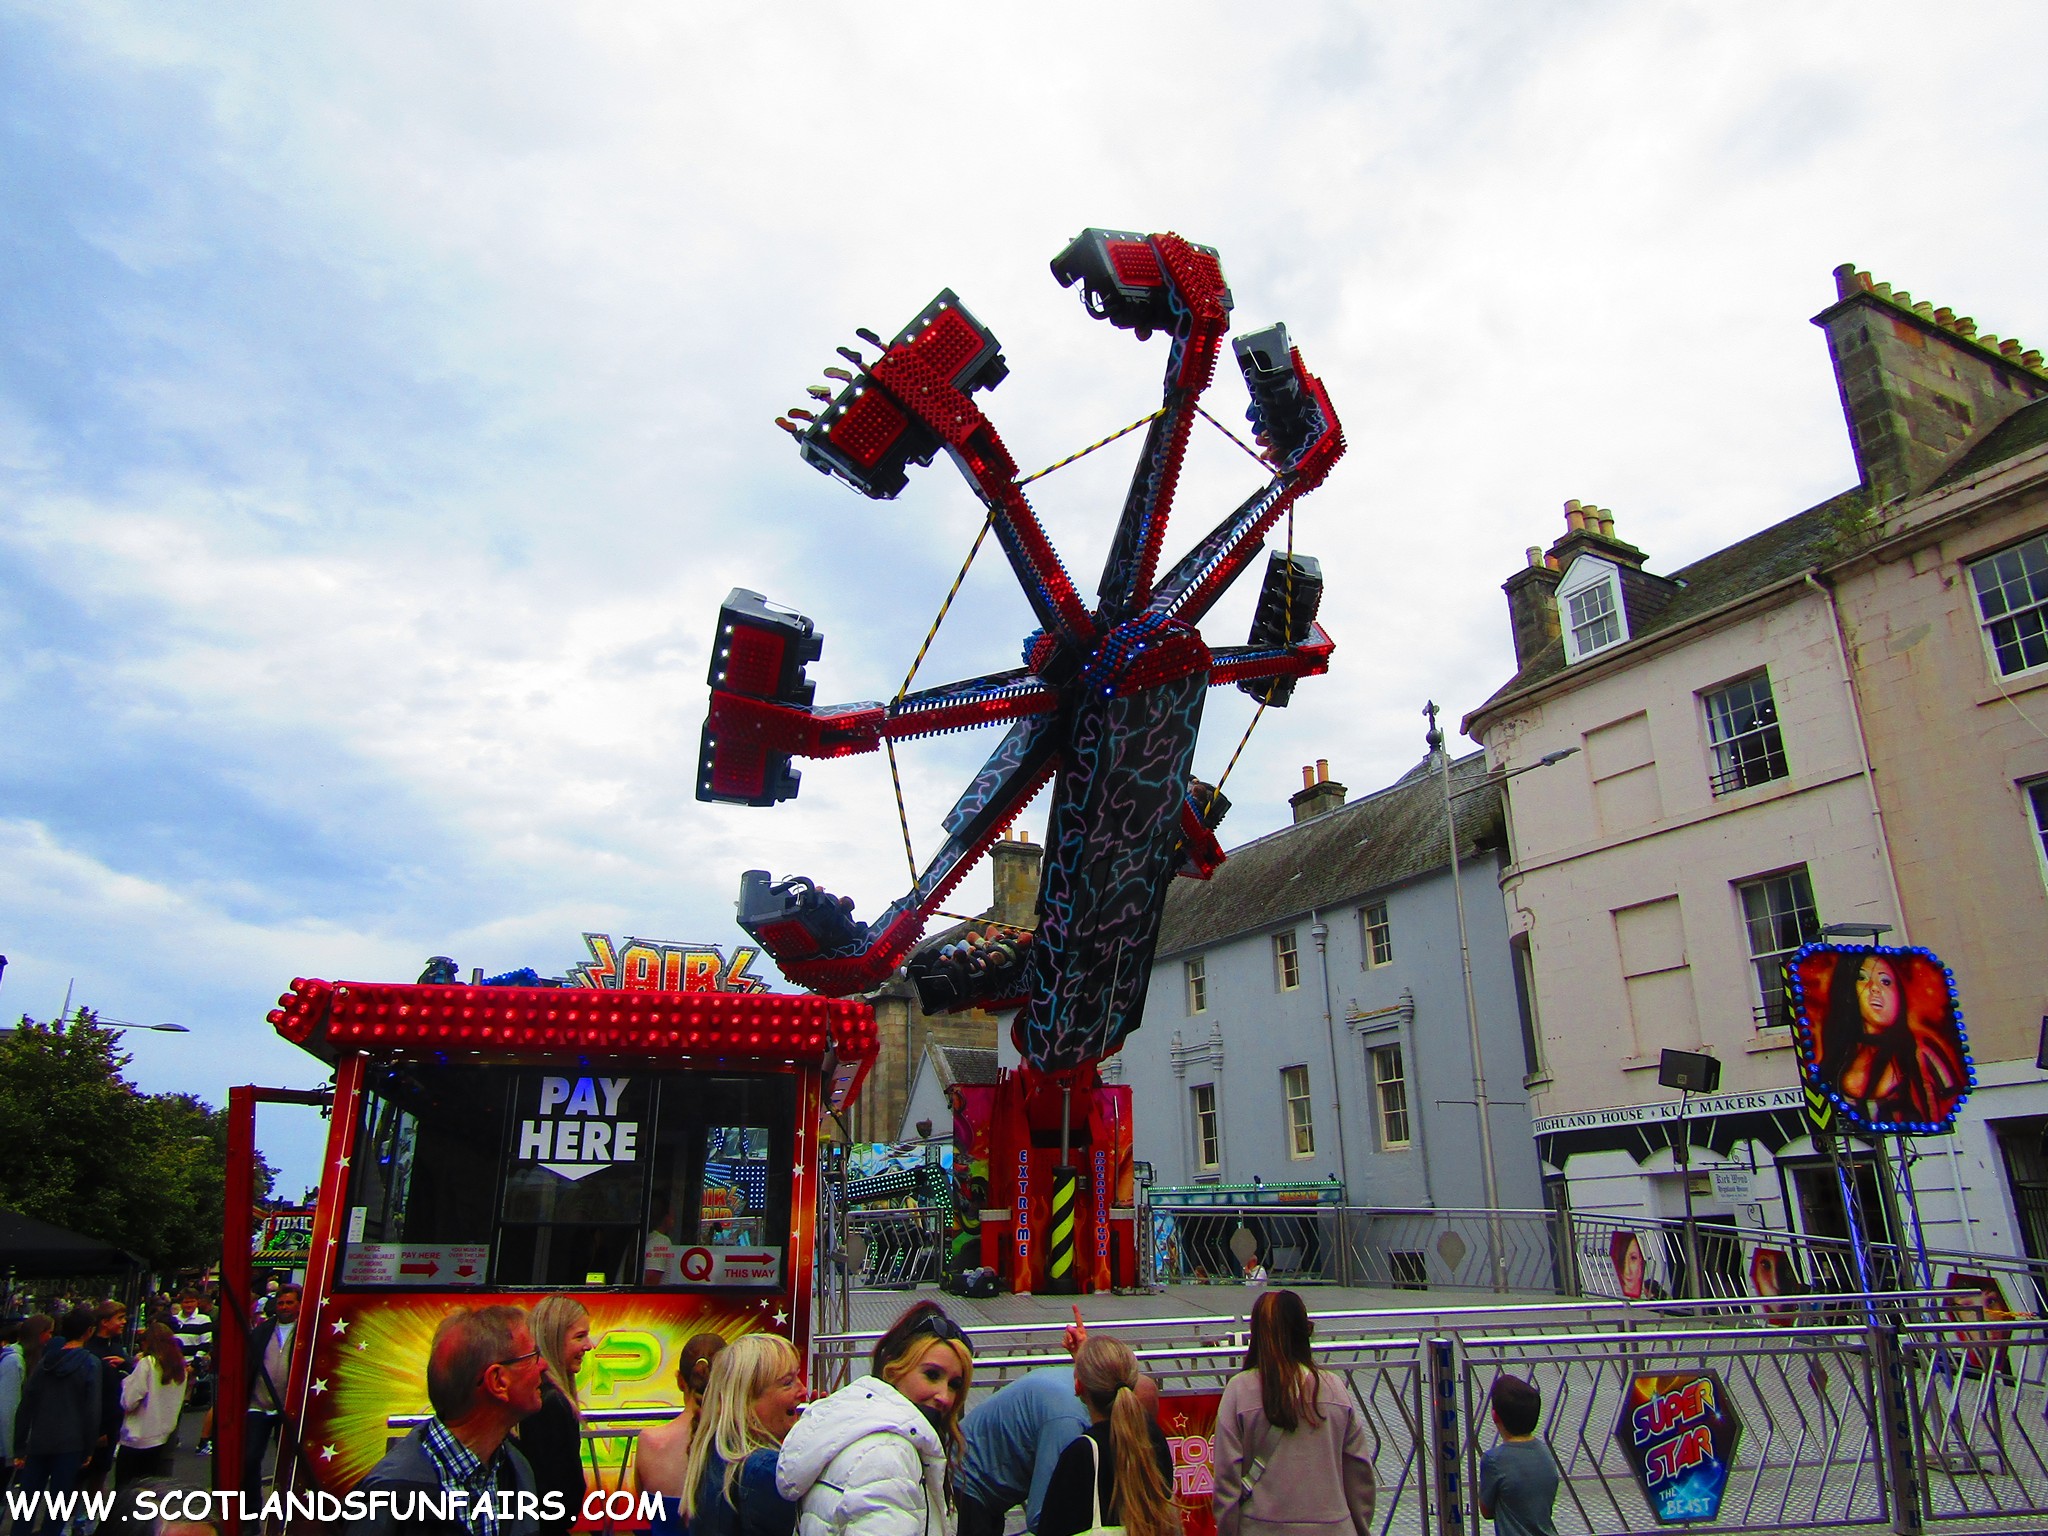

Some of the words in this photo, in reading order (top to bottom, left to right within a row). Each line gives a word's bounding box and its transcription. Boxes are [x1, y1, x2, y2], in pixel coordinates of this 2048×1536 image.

[620, 943, 724, 992] AIR
[540, 1076, 631, 1116] PAY
[1535, 1115, 1597, 1133] HIGHLAND
[1601, 1110, 1644, 1125] HOUSE
[1700, 1095, 1767, 1113] MAKERS
[519, 1120, 638, 1161] HERE
[1017, 1150, 1031, 1257] EXTREME
[275, 1216, 313, 1232] TOXIC
[401, 1252, 416, 1260] PAY
[418, 1252, 441, 1260] HERE
[680, 1246, 714, 1282] Q
[724, 1268, 749, 1278] THIS
[752, 1269, 775, 1278] WAY
[591, 1330, 662, 1396] P
[1633, 1377, 1716, 1445] SUPER
[1645, 1425, 1714, 1487] STAR
[1173, 1464, 1215, 1495] TA
[1659, 1487, 1677, 1501] THE
[1666, 1497, 1711, 1515] BEAST
